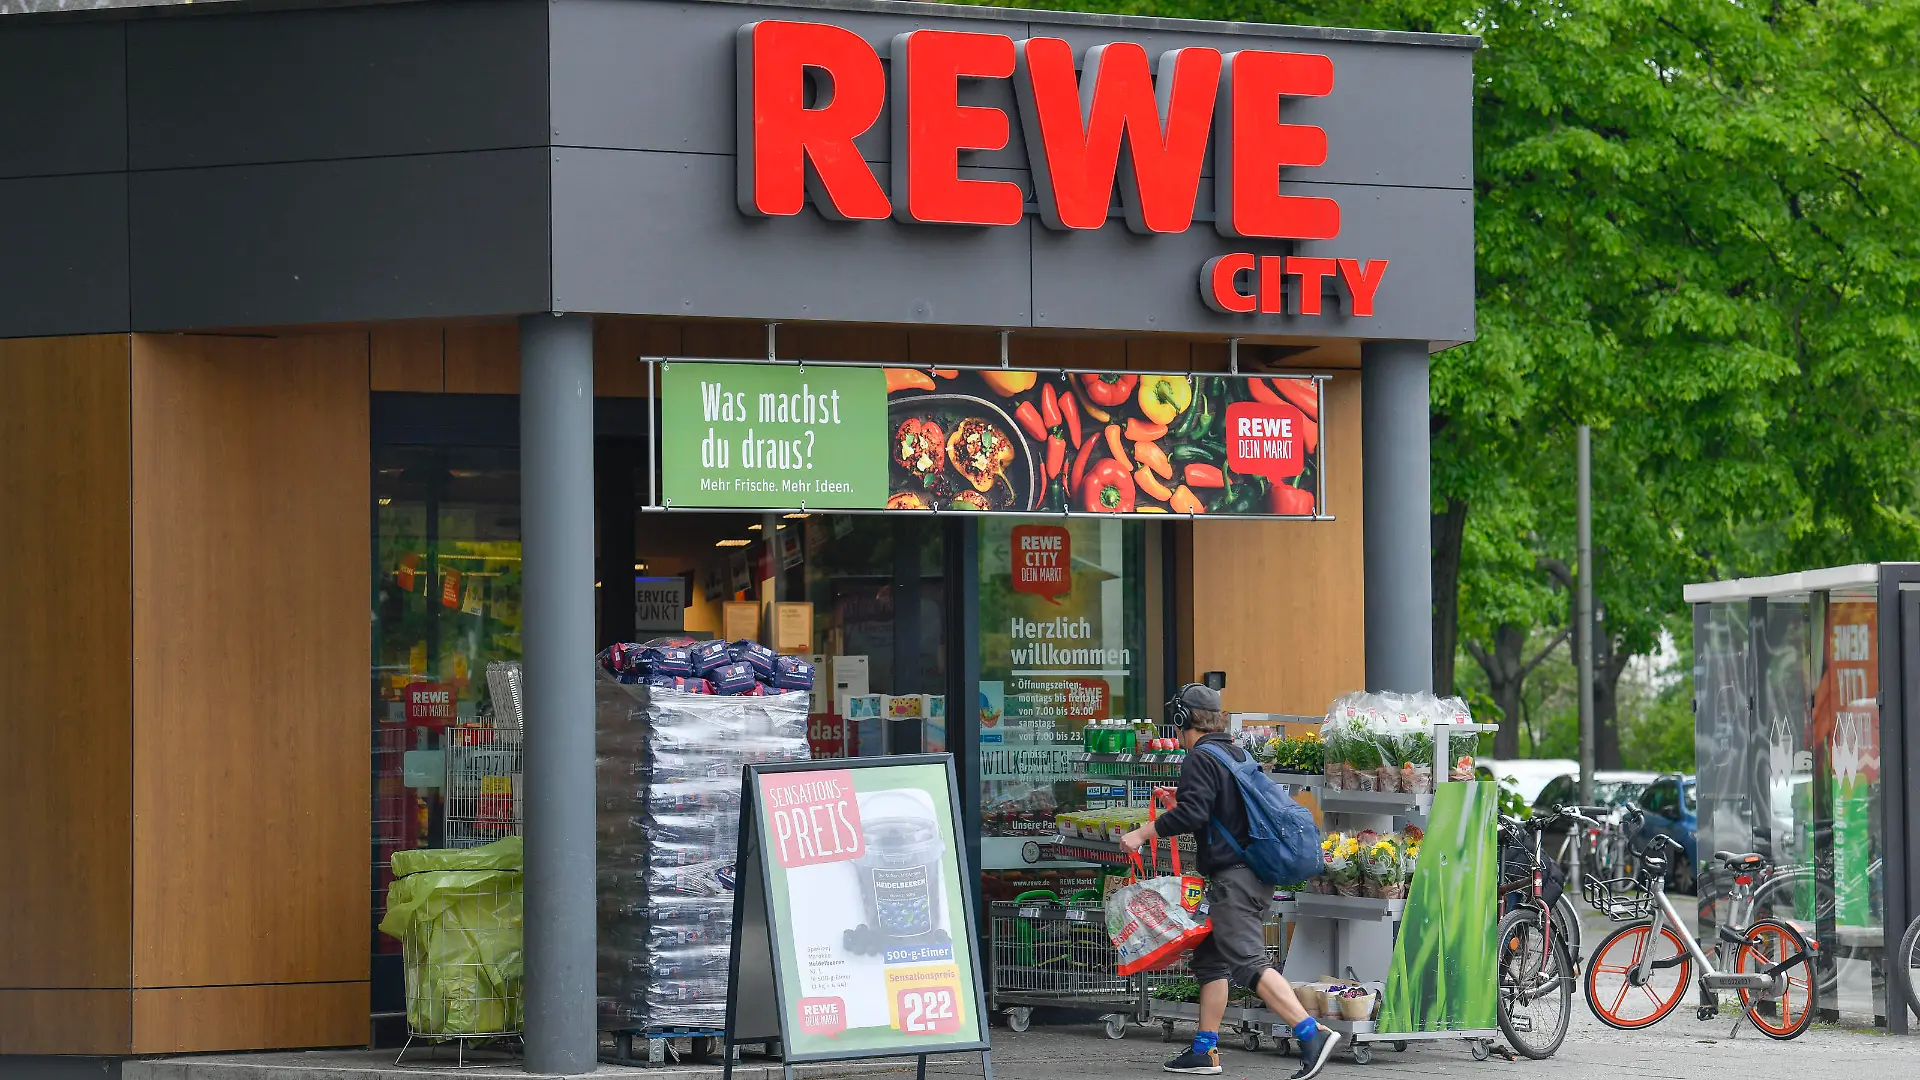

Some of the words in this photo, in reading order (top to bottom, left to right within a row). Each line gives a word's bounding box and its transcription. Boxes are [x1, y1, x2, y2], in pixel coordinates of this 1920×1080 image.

[750, 18, 1342, 240] REWE
[1208, 252, 1388, 317] CITY
[701, 382, 747, 422] Was
[758, 384, 841, 425] machst
[1238, 417, 1293, 438] REWE
[701, 428, 729, 469] du
[742, 428, 815, 470] draus?
[1239, 440, 1260, 459] DEIN
[1263, 440, 1293, 459] MARKT
[700, 478, 731, 491] Mehr
[735, 479, 779, 492] Frische.
[782, 479, 811, 492] Mehr
[815, 480, 854, 493] Ideen.
[1021, 535, 1062, 550] REWE
[1025, 551, 1058, 566] CITY
[1021, 568, 1038, 582] DEIN
[1039, 568, 1062, 582] MARKT
[637, 590, 679, 603] ERVICE
[640, 604, 679, 620] UNKT
[1011, 616, 1091, 639] Herzlich
[1010, 642, 1130, 665] willkommen
[1018, 679, 1082, 691] Öffnungszeiten:
[412, 692, 449, 703] REWE
[1018, 693, 1052, 703] montags
[1054, 693, 1067, 702] bis
[412, 705, 428, 717] DEIN
[429, 704, 449, 717] MARKT
[1018, 708, 1033, 716] von
[1035, 707, 1054, 716] 7.00
[1056, 707, 1068, 716] bis
[1070, 707, 1094, 716] 24.00
[1018, 719, 1056, 729] samstags
[1018, 733, 1033, 742] von
[1035, 732, 1054, 741] 7.00
[1056, 732, 1068, 741] bis
[1070, 732, 1084, 741] 23.
[769, 778, 849, 808] SENSATIONS-
[774, 800, 859, 862] PREIS
[1012, 820, 1040, 830] Unsere
[1042, 820, 1056, 829] Par
[875, 878, 926, 889] HEIDELBEEREN
[886, 947, 950, 962] 500-g-Eimer
[889, 969, 956, 984] Sensationspreis
[803, 1002, 839, 1016] REWE
[903, 990, 953, 1032] 2.22
